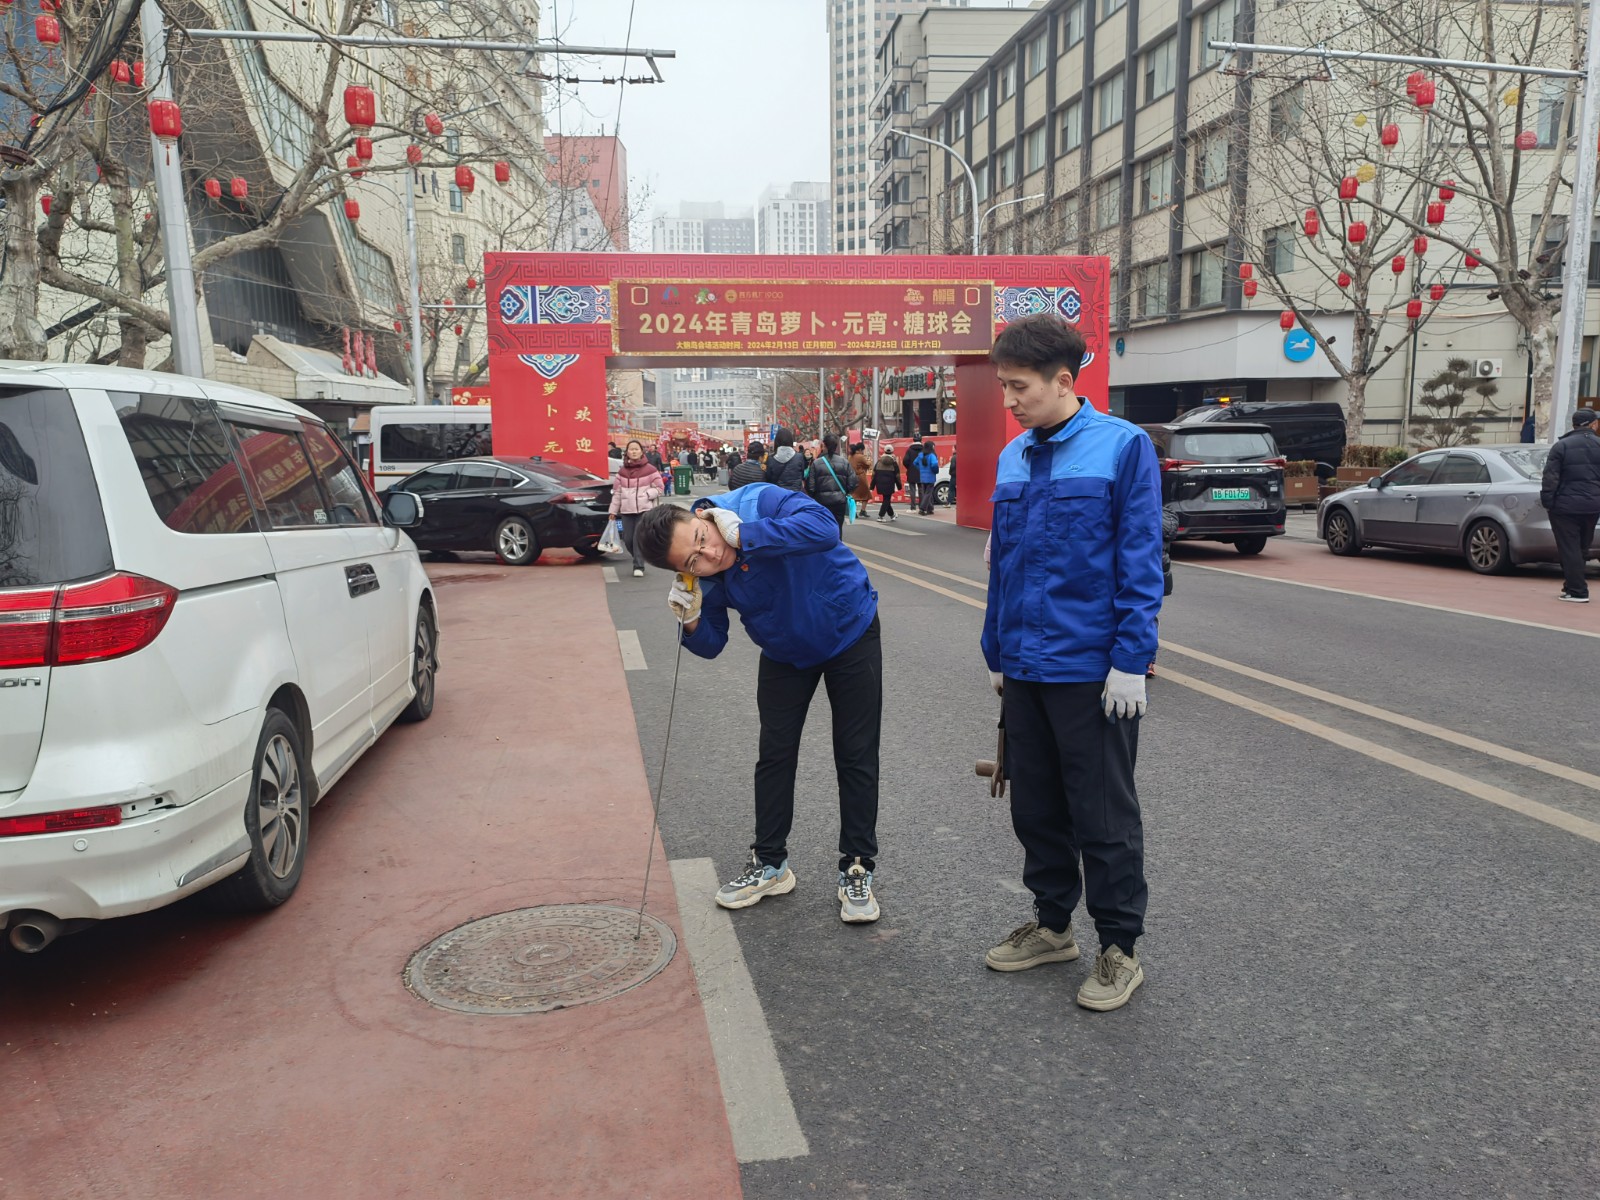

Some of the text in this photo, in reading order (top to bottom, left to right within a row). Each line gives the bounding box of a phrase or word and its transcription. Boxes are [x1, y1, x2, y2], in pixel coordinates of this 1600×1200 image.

[638, 310, 972, 336] 2024年青岛萝卜·元宵·糖球会
